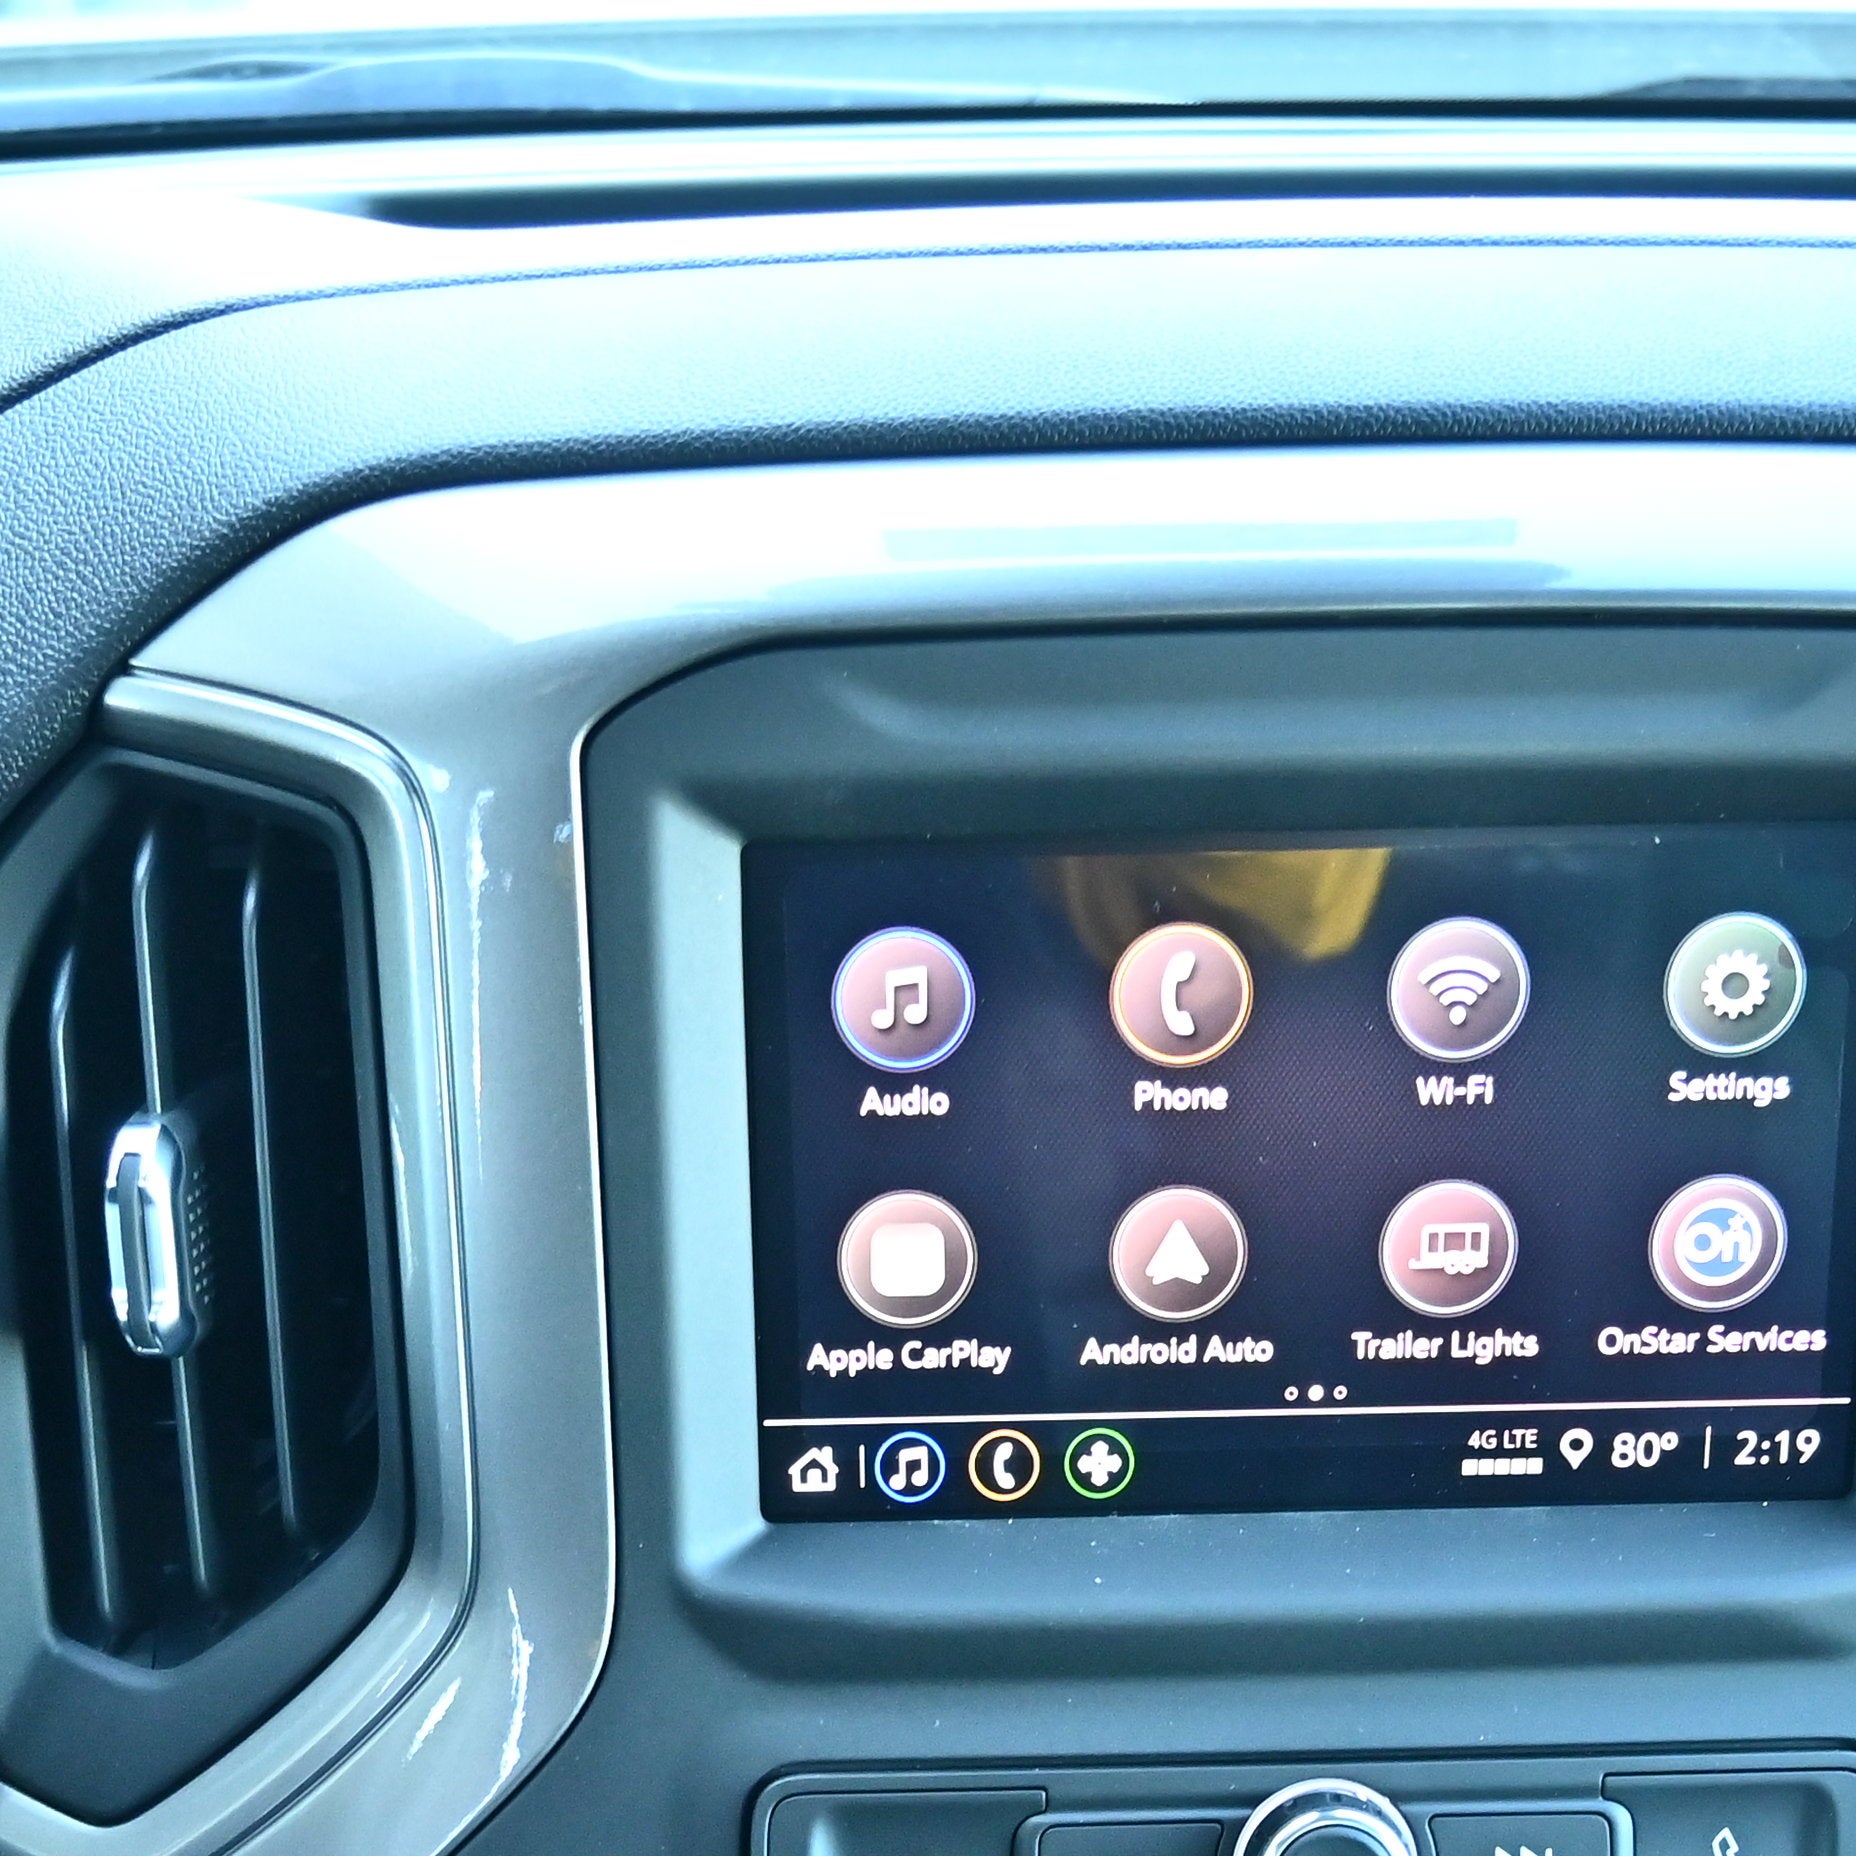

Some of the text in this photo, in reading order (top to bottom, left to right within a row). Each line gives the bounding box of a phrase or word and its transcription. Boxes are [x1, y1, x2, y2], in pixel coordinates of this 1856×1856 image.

[859, 1084, 950, 1117] Audio
[1133, 1080, 1229, 1112] Phone
[1415, 1074, 1494, 1106] Wi-Fi
[1667, 1070, 1791, 1108] Settings
[1079, 1334, 1274, 1366] Android Auto
[1351, 1328, 1540, 1366] Trailer Lights
[1597, 1324, 1827, 1356] OnStar Services
[806, 1338, 1012, 1378] Apple CarPlay
[1467, 1428, 1539, 1450] 4G LTE
[1733, 1428, 1820, 1466] 2:19
